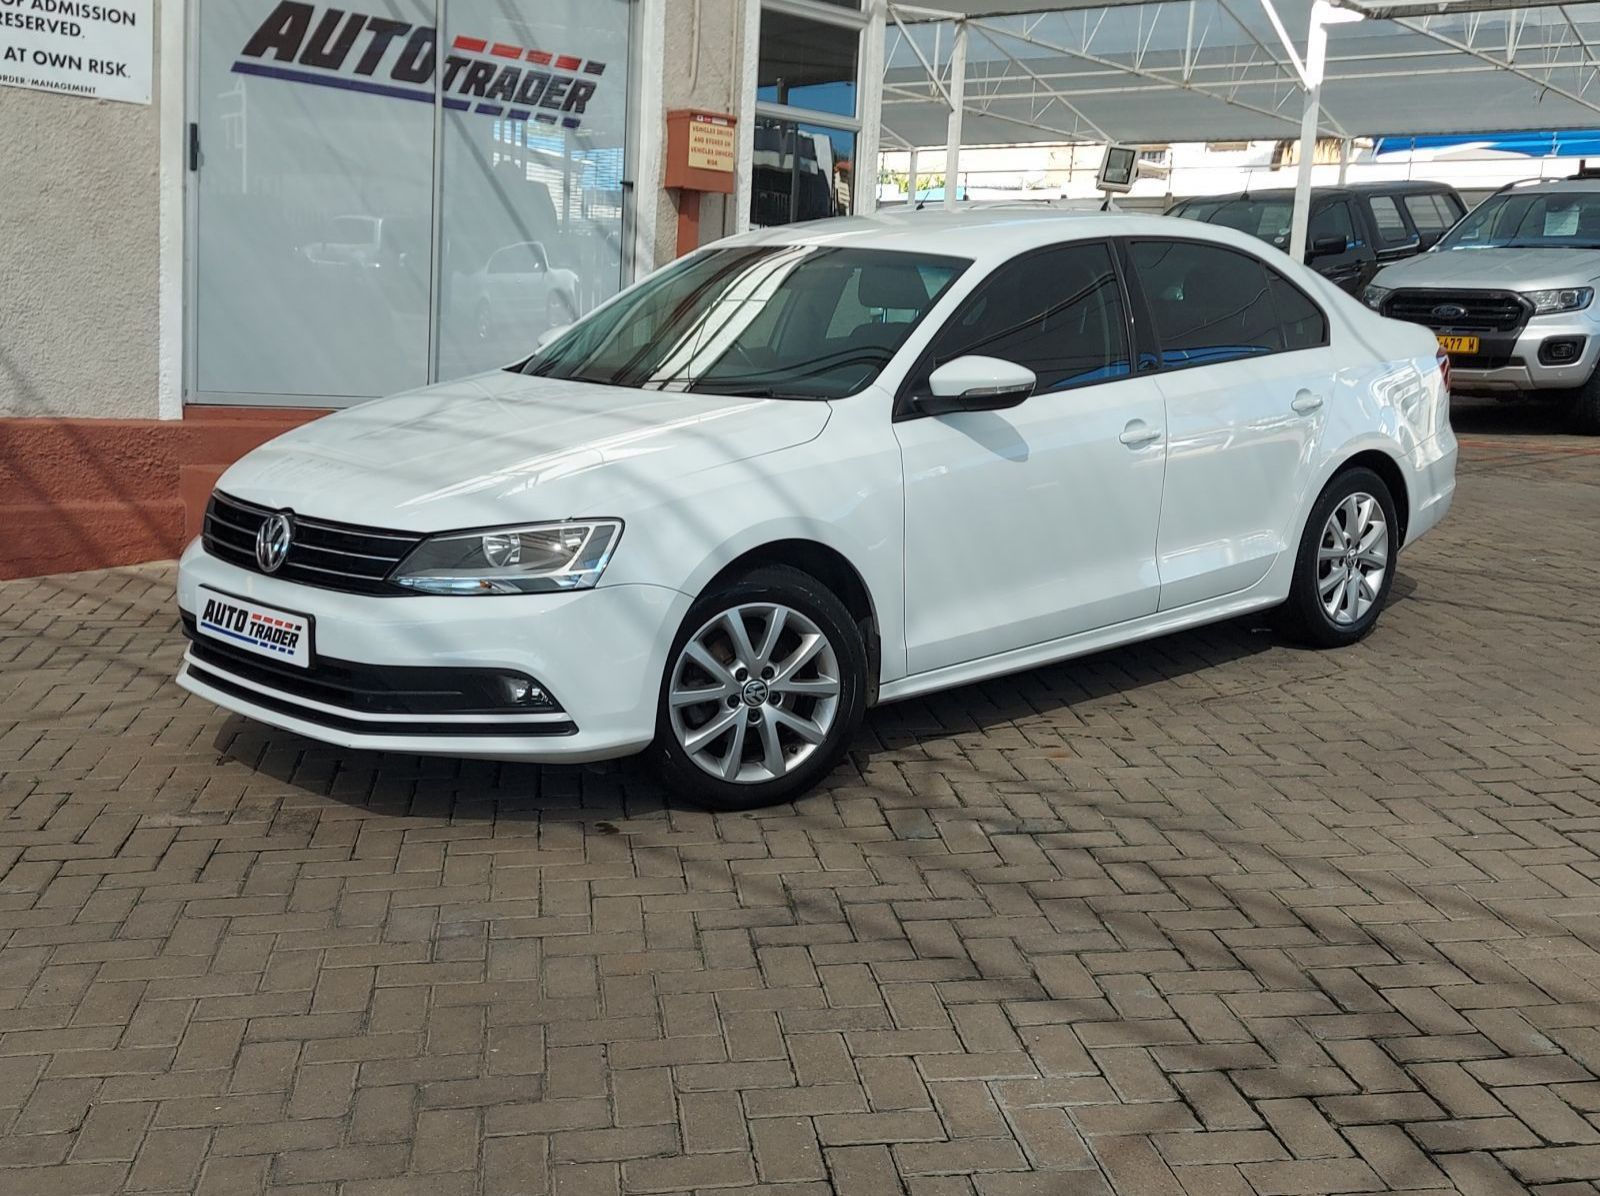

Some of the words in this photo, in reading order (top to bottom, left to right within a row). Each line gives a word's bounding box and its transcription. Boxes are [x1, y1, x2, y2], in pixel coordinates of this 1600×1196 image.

[31, 0, 136, 26] ADMISSION
[4, 46, 27, 62] AT
[33, 50, 82, 71] OWN
[88, 58, 131, 78] RISK.
[241, 0, 437, 83] AUTO
[442, 55, 598, 114] TRADER
[202, 599, 249, 633] AUTO
[249, 621, 300, 648] TRADER
